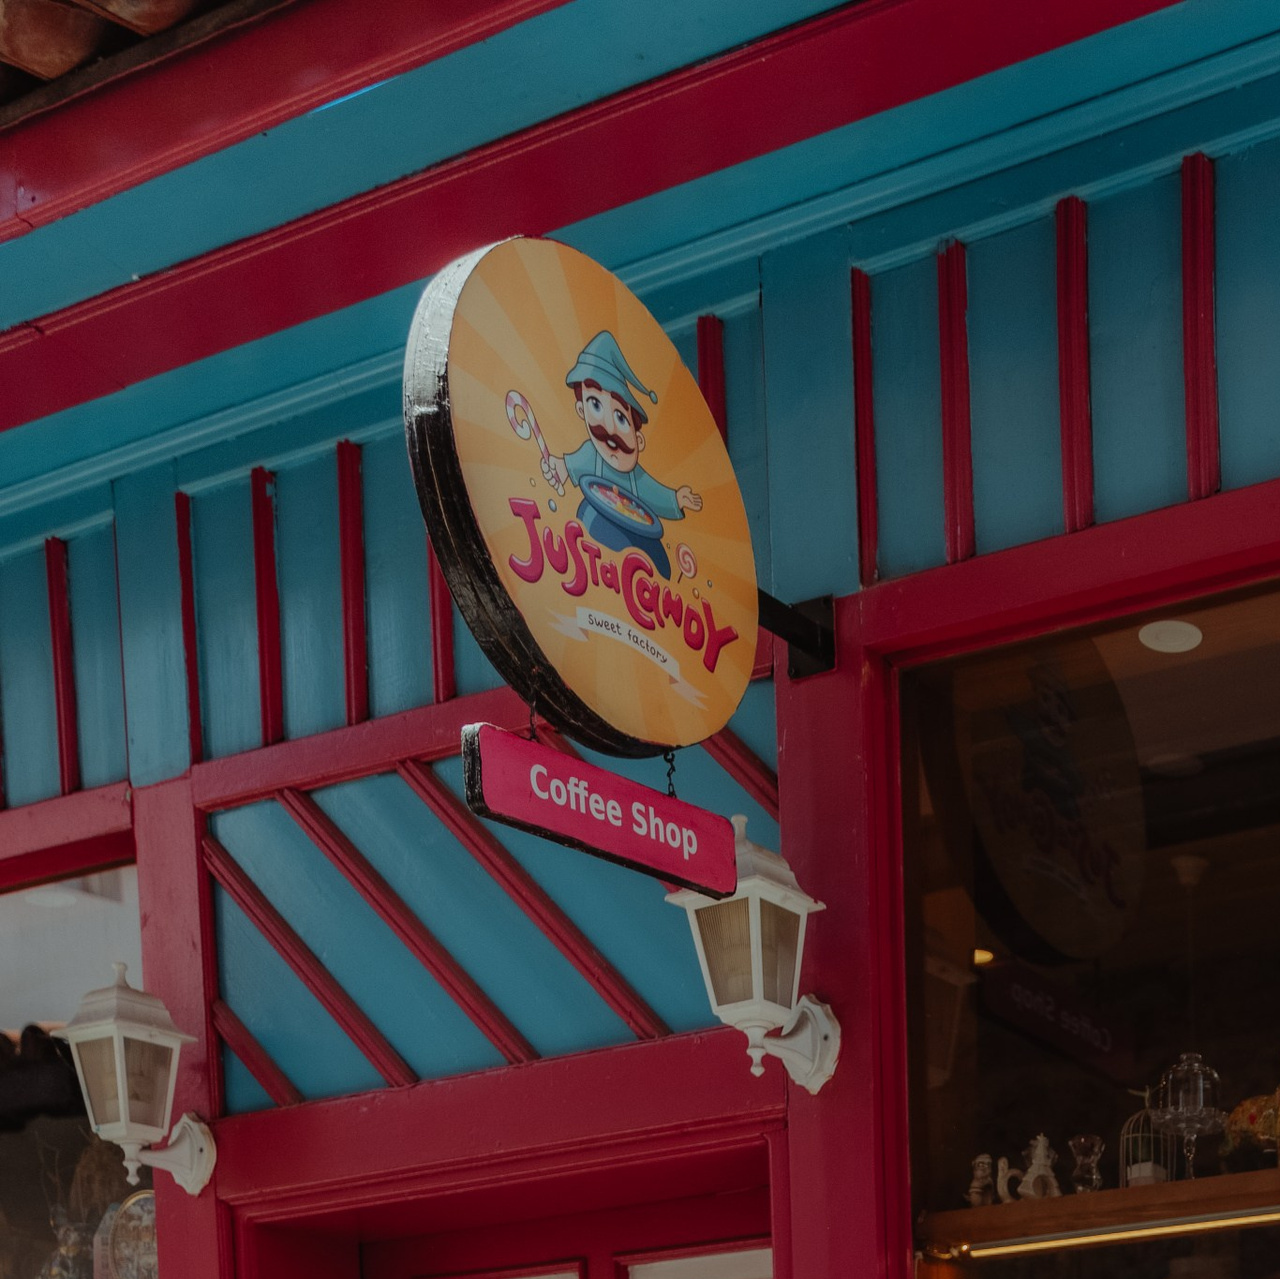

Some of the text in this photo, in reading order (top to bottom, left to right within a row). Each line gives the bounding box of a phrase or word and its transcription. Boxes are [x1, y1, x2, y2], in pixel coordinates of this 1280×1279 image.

[587, 613, 668, 664] sweet factory
[530, 763, 698, 861] Coffee Shop
